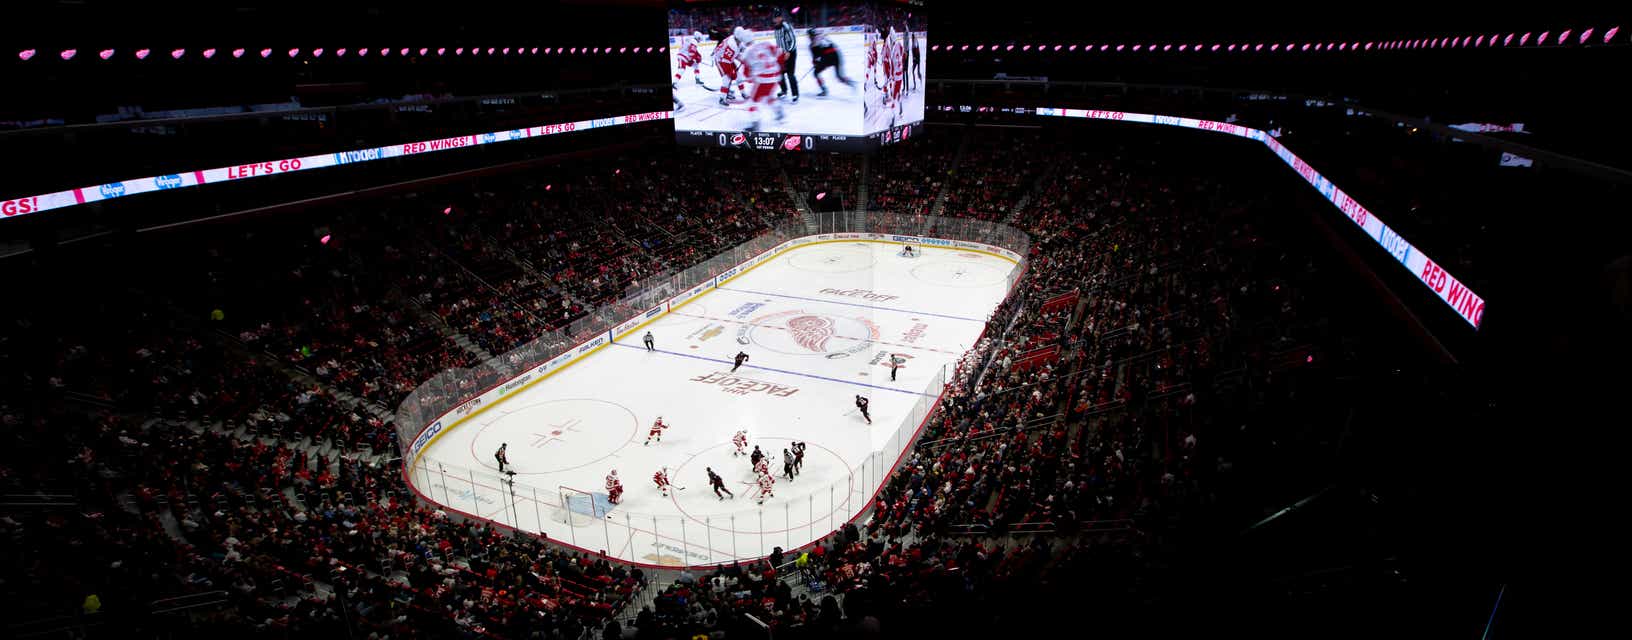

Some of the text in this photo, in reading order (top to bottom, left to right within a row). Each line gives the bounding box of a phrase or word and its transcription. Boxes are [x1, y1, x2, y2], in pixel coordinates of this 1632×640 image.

[541, 122, 575, 135] LET'S GO
[403, 136, 468, 154] RED WINGS!
[719, 133, 727, 146] 0
[754, 136, 775, 145] 13:07
[805, 136, 813, 150] 0
[228, 158, 302, 179] LET'S GO
[2, 196, 38, 216] GS!
[1341, 195, 1357, 218] LET'S
[1421, 260, 1447, 293] RED
[414, 422, 442, 453] GEICO
